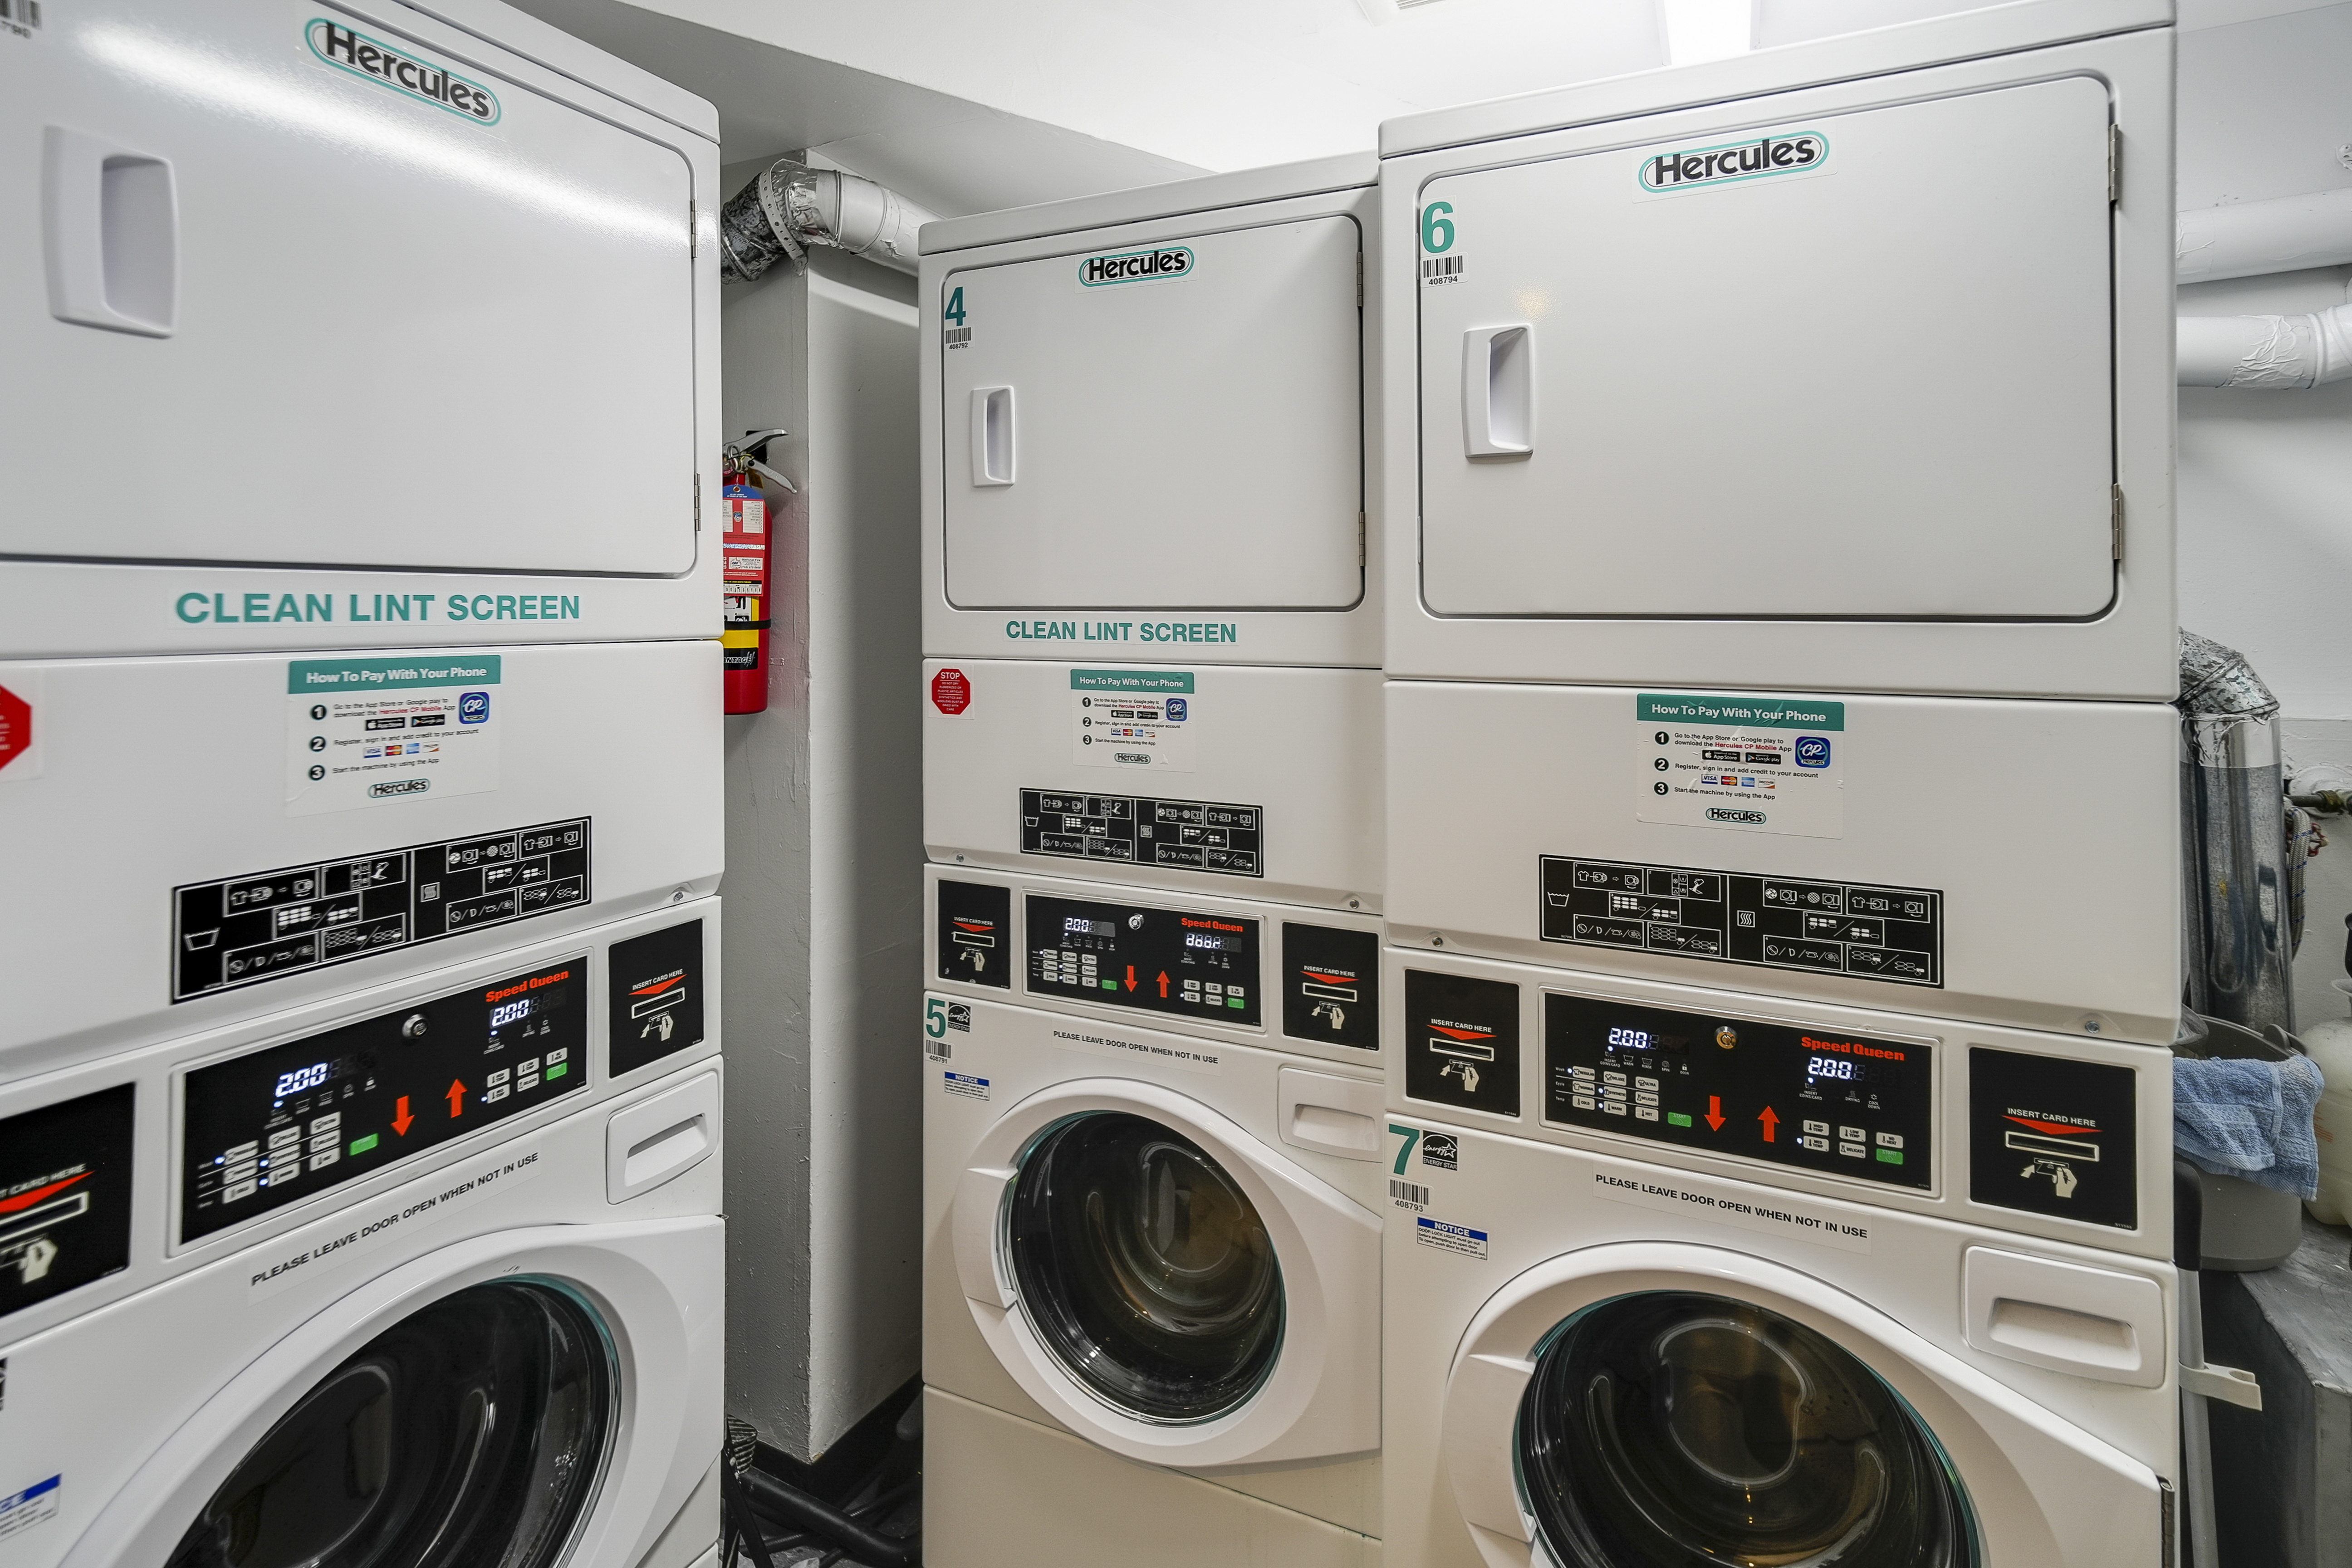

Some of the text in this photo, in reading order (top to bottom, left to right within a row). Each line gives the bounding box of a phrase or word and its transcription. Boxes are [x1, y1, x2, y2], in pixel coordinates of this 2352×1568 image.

[325, 22, 489, 119] Hercules
[1656, 139, 1814, 185] Hercules
[1421, 201, 1455, 253] 6
[1089, 250, 1185, 281] Hercules
[1429, 275, 1458, 285] 408794
[945, 287, 966, 326] 4
[176, 593, 579, 623] CLEAN LINT SCREEN
[1006, 621, 1236, 642] CLEAN LINT SCREEN
[306, 667, 487, 683] How To Pay With Your Phone
[1107, 678, 1121, 686] Pay
[314, 706, 323, 718] 1
[465, 699, 483, 712] CP
[1171, 704, 1182, 712] CP
[1652, 704, 1826, 722] How To Pay With Your Phone
[313, 738, 323, 750] 2
[1658, 733, 1664, 743] 1
[1118, 753, 1148, 762] Hercules
[1802, 744, 1822, 756] CP
[1658, 760, 1665, 769] 2
[312, 766, 323, 779] 3
[373, 780, 426, 795] Hercules
[1657, 784, 1665, 793] 3
[1711, 808, 1762, 822] Hercules
[1065, 917, 1089, 932] 2.00
[1181, 918, 1243, 932] Speed Queen
[486, 971, 568, 1002] Speed Queen
[632, 969, 683, 990] INSERT CARD HERE
[491, 999, 529, 1027] 2.00
[926, 998, 946, 1038] 5
[1431, 1018, 1492, 1033] INSERT CARD HERE
[1609, 1027, 1648, 1049] 2.00
[1054, 1031, 1079, 1041] PLEASE
[1082, 1035, 1104, 1045] LEAVE
[1106, 1039, 1127, 1049] DOOR
[1128, 1043, 1148, 1053] OPEN
[1151, 1047, 1173, 1057] WHEN
[1175, 1051, 1191, 1059] NOT
[1203, 1055, 1218, 1064] USE
[1801, 1037, 1905, 1061] Speed Queen
[929, 1055, 947, 1063] 408791
[1808, 1057, 1852, 1080] 2.00
[275, 1063, 328, 1098] 2.00
[955, 1074, 978, 1084] NOTICE
[2007, 1107, 2096, 1127] INSERT CARD HERE
[1389, 1123, 1420, 1175] 7
[1423, 1158, 1442, 1166] ENERGY
[1395, 1200, 1424, 1212] 408793
[1596, 1175, 1867, 1239] PLEASE LEAVE DOOR OPEN WHEN NOT IN USE
[251, 1152, 538, 1287] PLEASE LEAVE DOOR OPEN WHEN NOT IN USE
[1435, 1222, 1470, 1237] NOTICE
